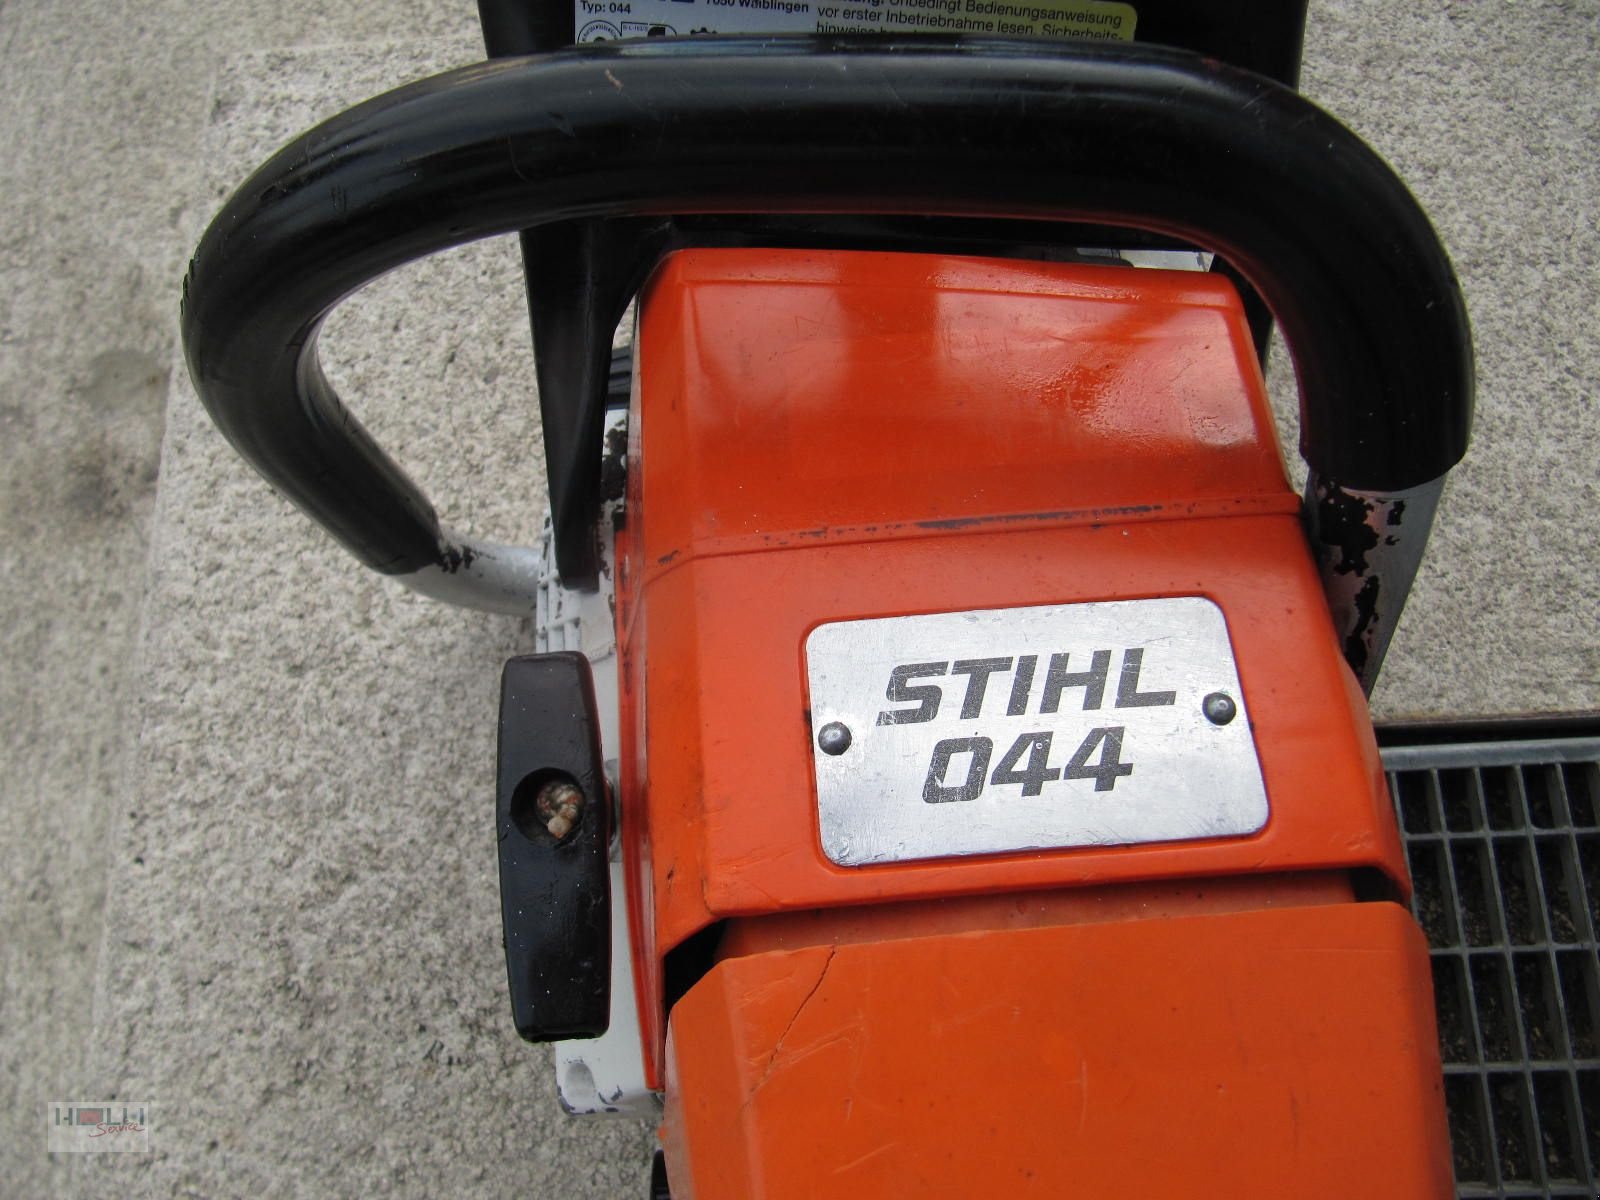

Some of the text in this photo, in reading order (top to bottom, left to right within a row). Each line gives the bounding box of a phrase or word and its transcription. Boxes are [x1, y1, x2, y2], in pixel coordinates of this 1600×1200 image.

[580, 0, 632, 14] Typ: 044
[739, 0, 809, 14] Waiblingen
[817, 7, 839, 18] vor
[842, 8, 882, 22] erster
[886, 9, 993, 32] Inbetriebnahme
[965, 0, 1122, 28] Bedienungsanweisung
[875, 647, 1177, 727] STIHL
[922, 725, 1134, 804] 044
